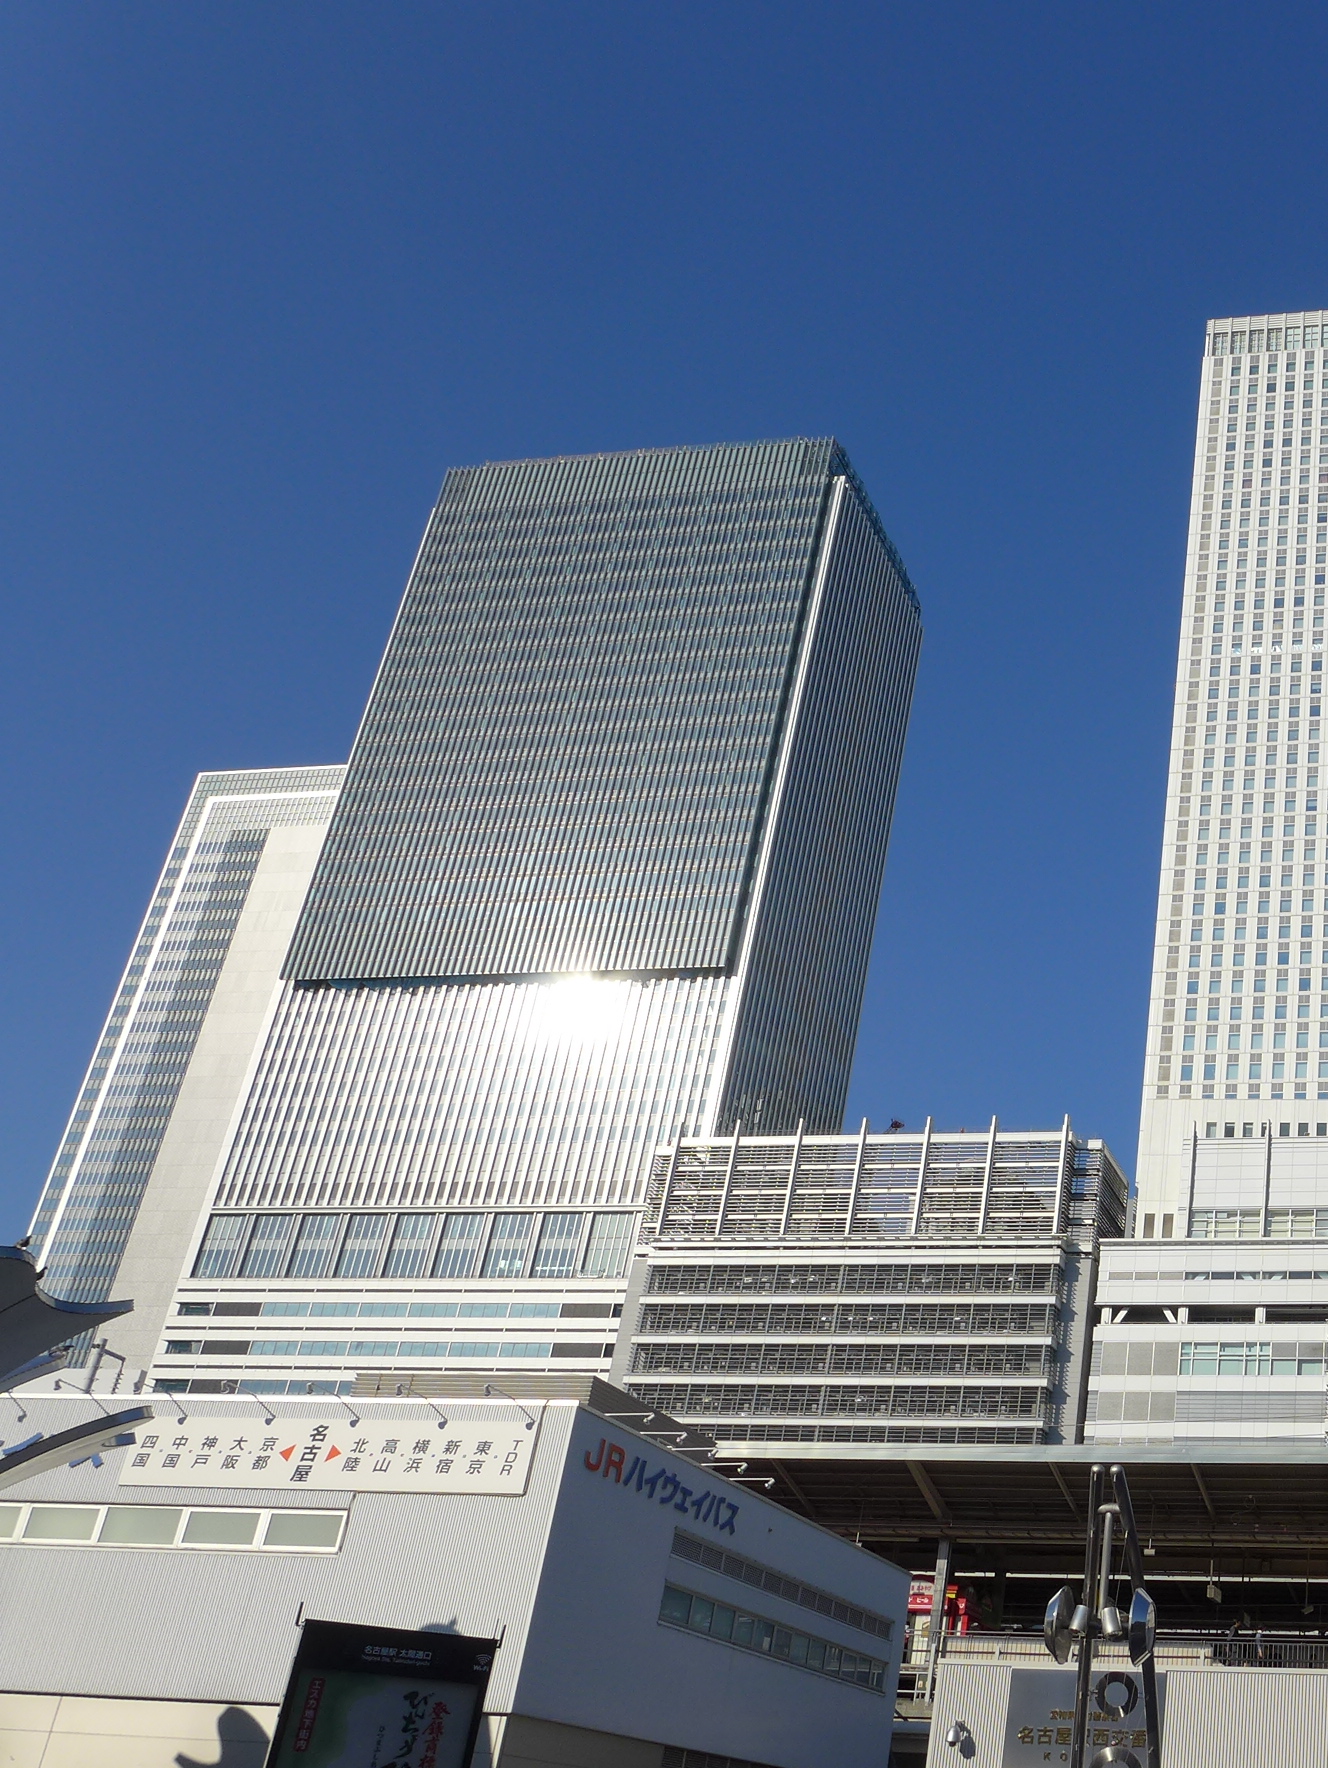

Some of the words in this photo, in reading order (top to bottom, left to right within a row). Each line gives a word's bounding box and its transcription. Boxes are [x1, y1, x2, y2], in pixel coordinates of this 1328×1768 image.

[131, 1435, 159, 1468] 四国
[161, 1435, 189, 1469] 中国
[190, 1435, 219, 1469] 神戸
[220, 1436, 248, 1470] 大阪
[251, 1436, 279, 1471] 京都
[289, 1424, 330, 1483] 名古屋
[341, 1438, 369, 1472] 北陸
[372, 1439, 401, 1473] 高山
[403, 1439, 431, 1474] 横浜
[435, 1439, 463, 1475] 新宿
[465, 1440, 493, 1475] 東京
[499, 1439, 524, 1476] TDR
[584, 1438, 740, 1535] JRハイウェイバス
